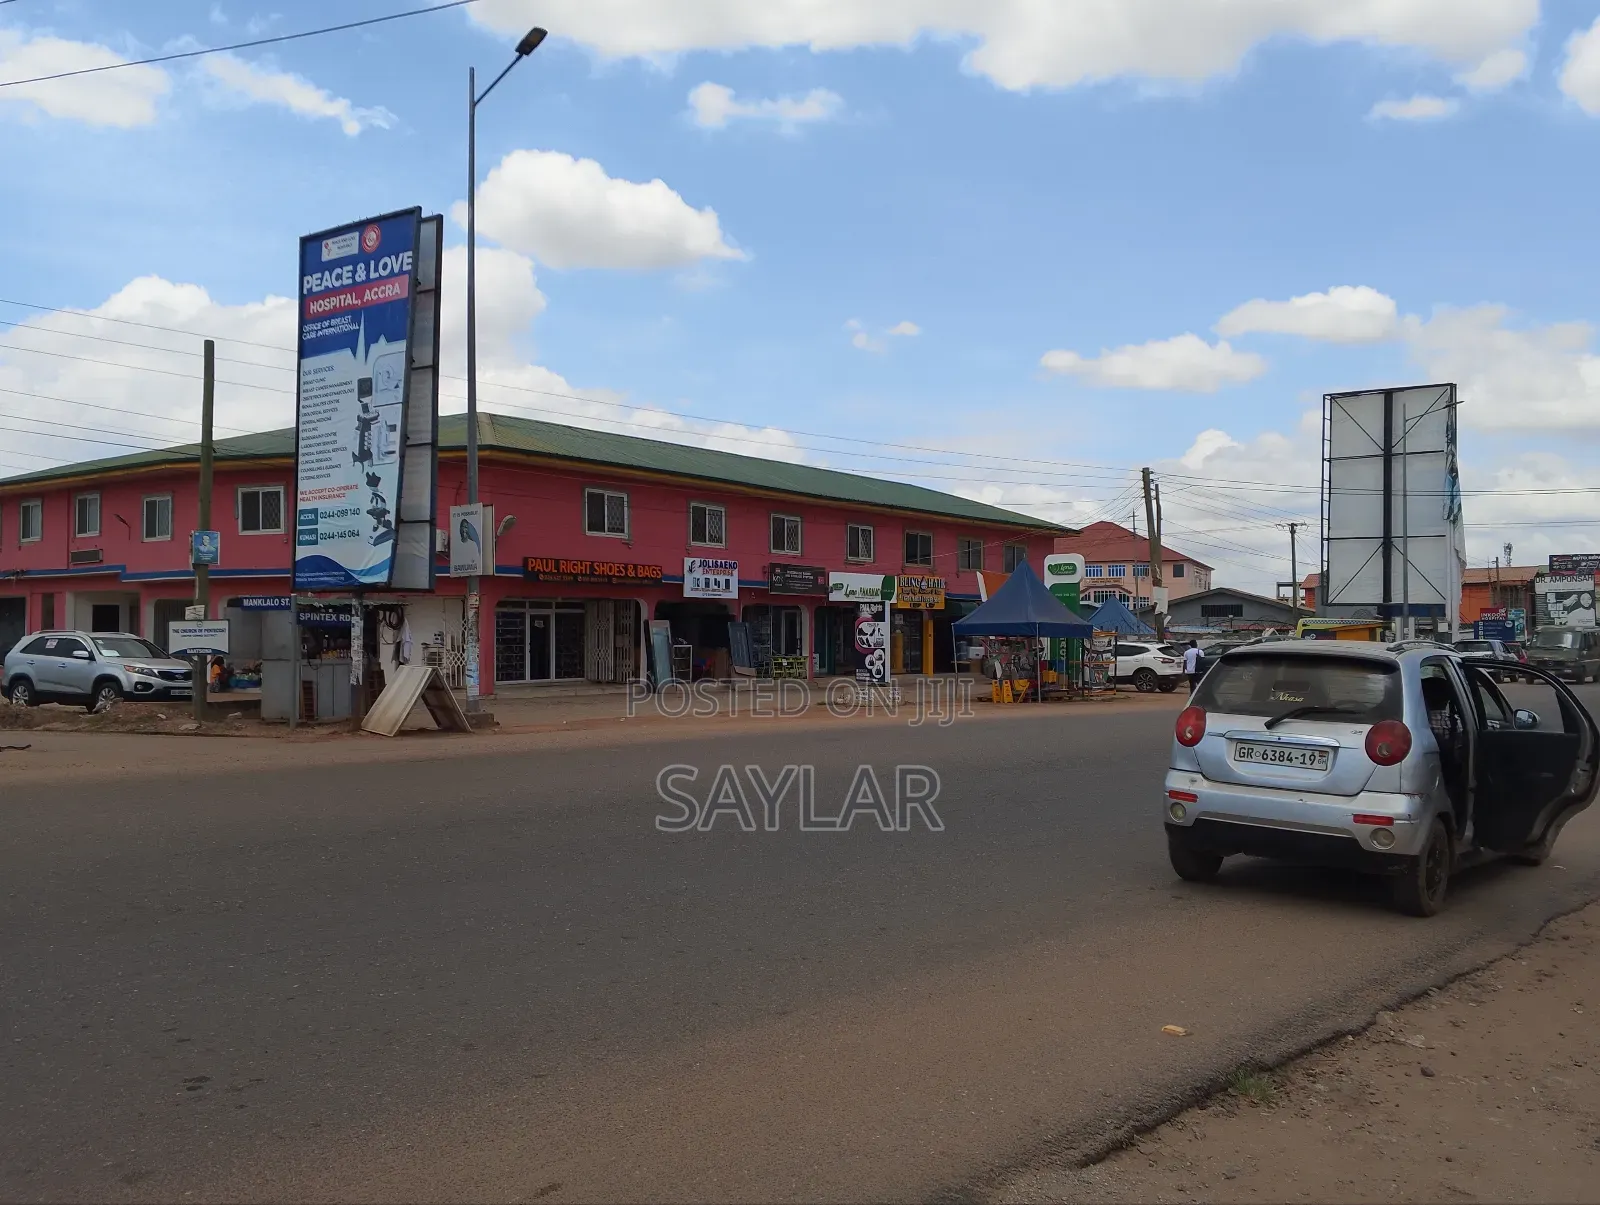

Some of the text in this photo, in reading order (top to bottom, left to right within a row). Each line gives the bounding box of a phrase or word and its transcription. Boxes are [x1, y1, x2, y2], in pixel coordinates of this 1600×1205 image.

[303, 250, 413, 294] PEACE & LOVE
[310, 282, 400, 314] HOSPITAL, ACCRA
[303, 315, 352, 332] OFFICE OF BREAST
[302, 322, 360, 340] CARE INTERNATIONAL
[349, 508, 360, 516] 140
[528, 558, 662, 579] PAUL RIGHT SHOES & BAGS
[698, 559, 738, 570] JOLISAEKO
[702, 568, 734, 577] ENTERPRISE
[899, 576, 920, 587] BLING
[1536, 575, 1593, 584] DR. AMPONSAH
[243, 598, 290, 606] MANKLALO ST.
[300, 612, 337, 621] SPINTEX
[1238, 747, 1316, 766] GR 6384-19
[1318, 757, 1326, 765] GH
